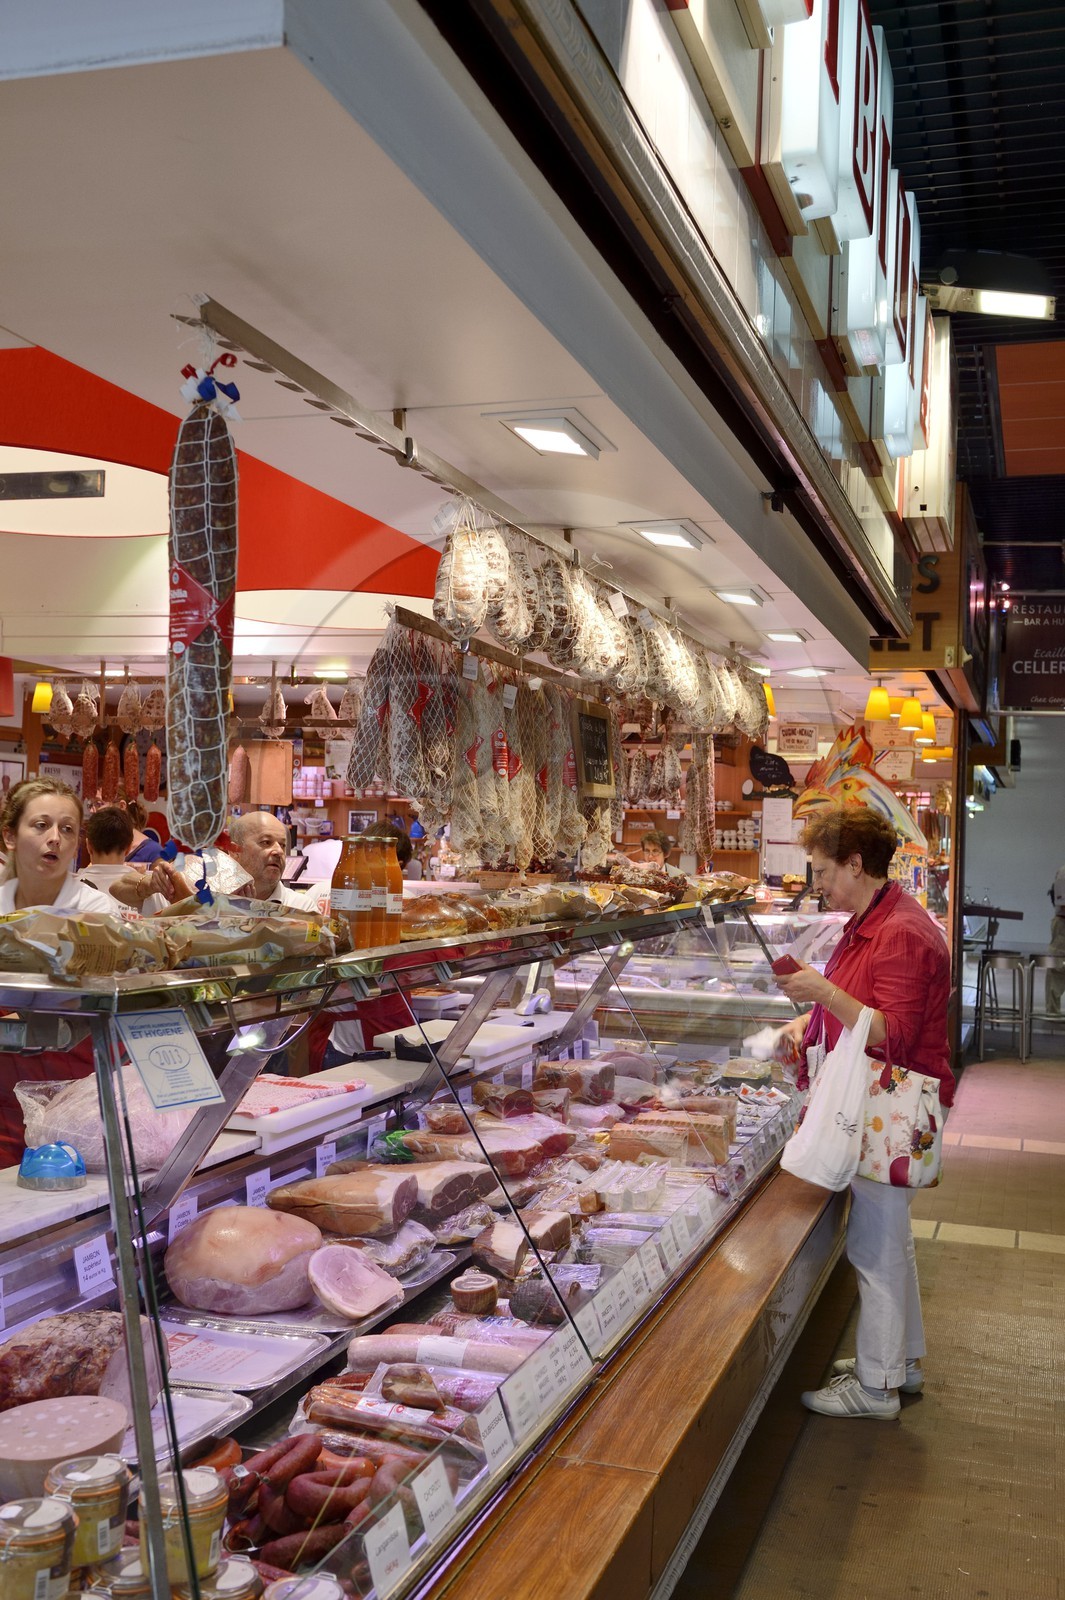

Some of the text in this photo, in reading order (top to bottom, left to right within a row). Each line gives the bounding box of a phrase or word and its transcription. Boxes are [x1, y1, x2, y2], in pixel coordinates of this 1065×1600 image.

[1012, 605, 1065, 614] RESTAU
[1024, 618, 1041, 626] BAR
[131, 1030, 144, 1039] ET
[155, 1048, 183, 1066] 2013
[82, 1250, 100, 1264] JAMBON
